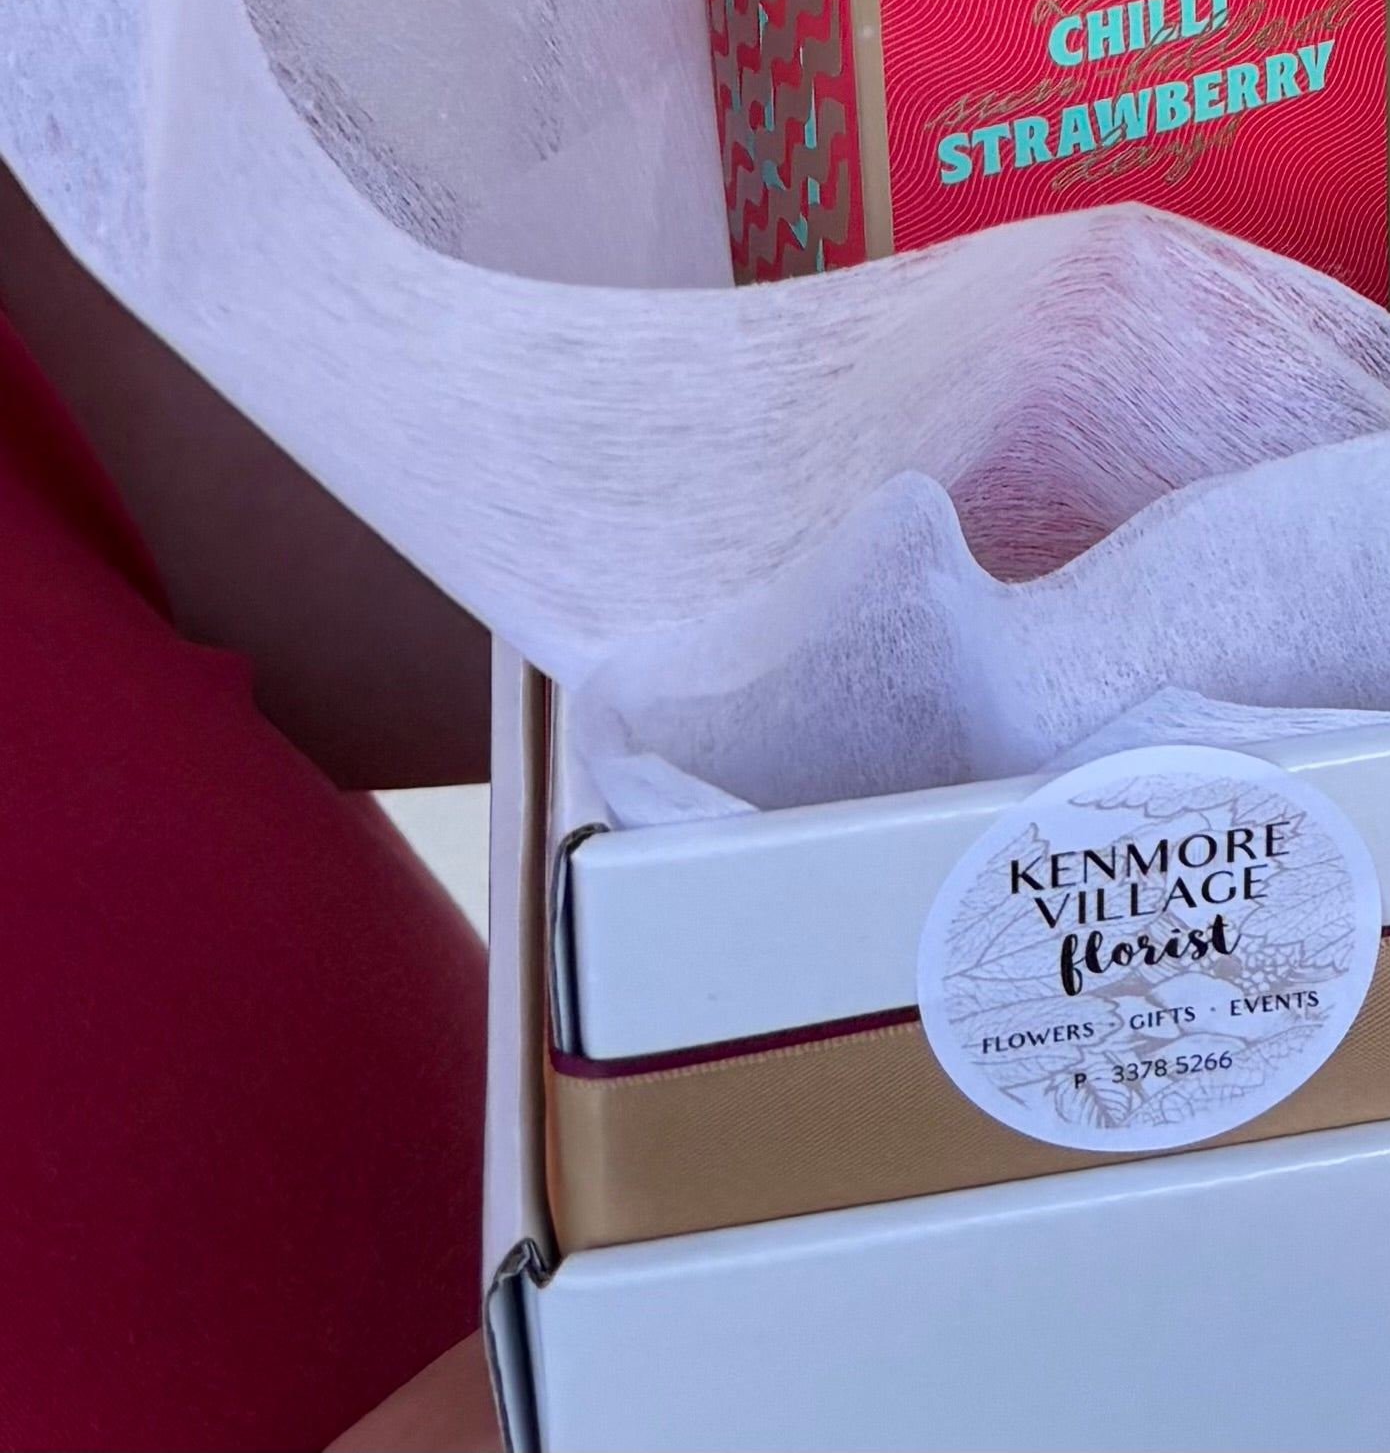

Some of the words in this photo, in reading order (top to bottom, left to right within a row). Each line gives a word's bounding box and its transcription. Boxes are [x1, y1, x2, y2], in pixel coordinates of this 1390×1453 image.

[936, 39, 1336, 186] STRAWBERRY
[1009, 820, 1292, 894] KENMORE
[1033, 863, 1269, 929] VILLAGE
[1059, 913, 1243, 997] florist
[981, 1021, 1095, 1055] FLOWERS
[1128, 1005, 1197, 1031] GIFTS
[1229, 990, 1321, 1017] EVENTS
[1111, 1058, 1168, 1084] 3378
[1175, 1050, 1233, 1075] 5266
